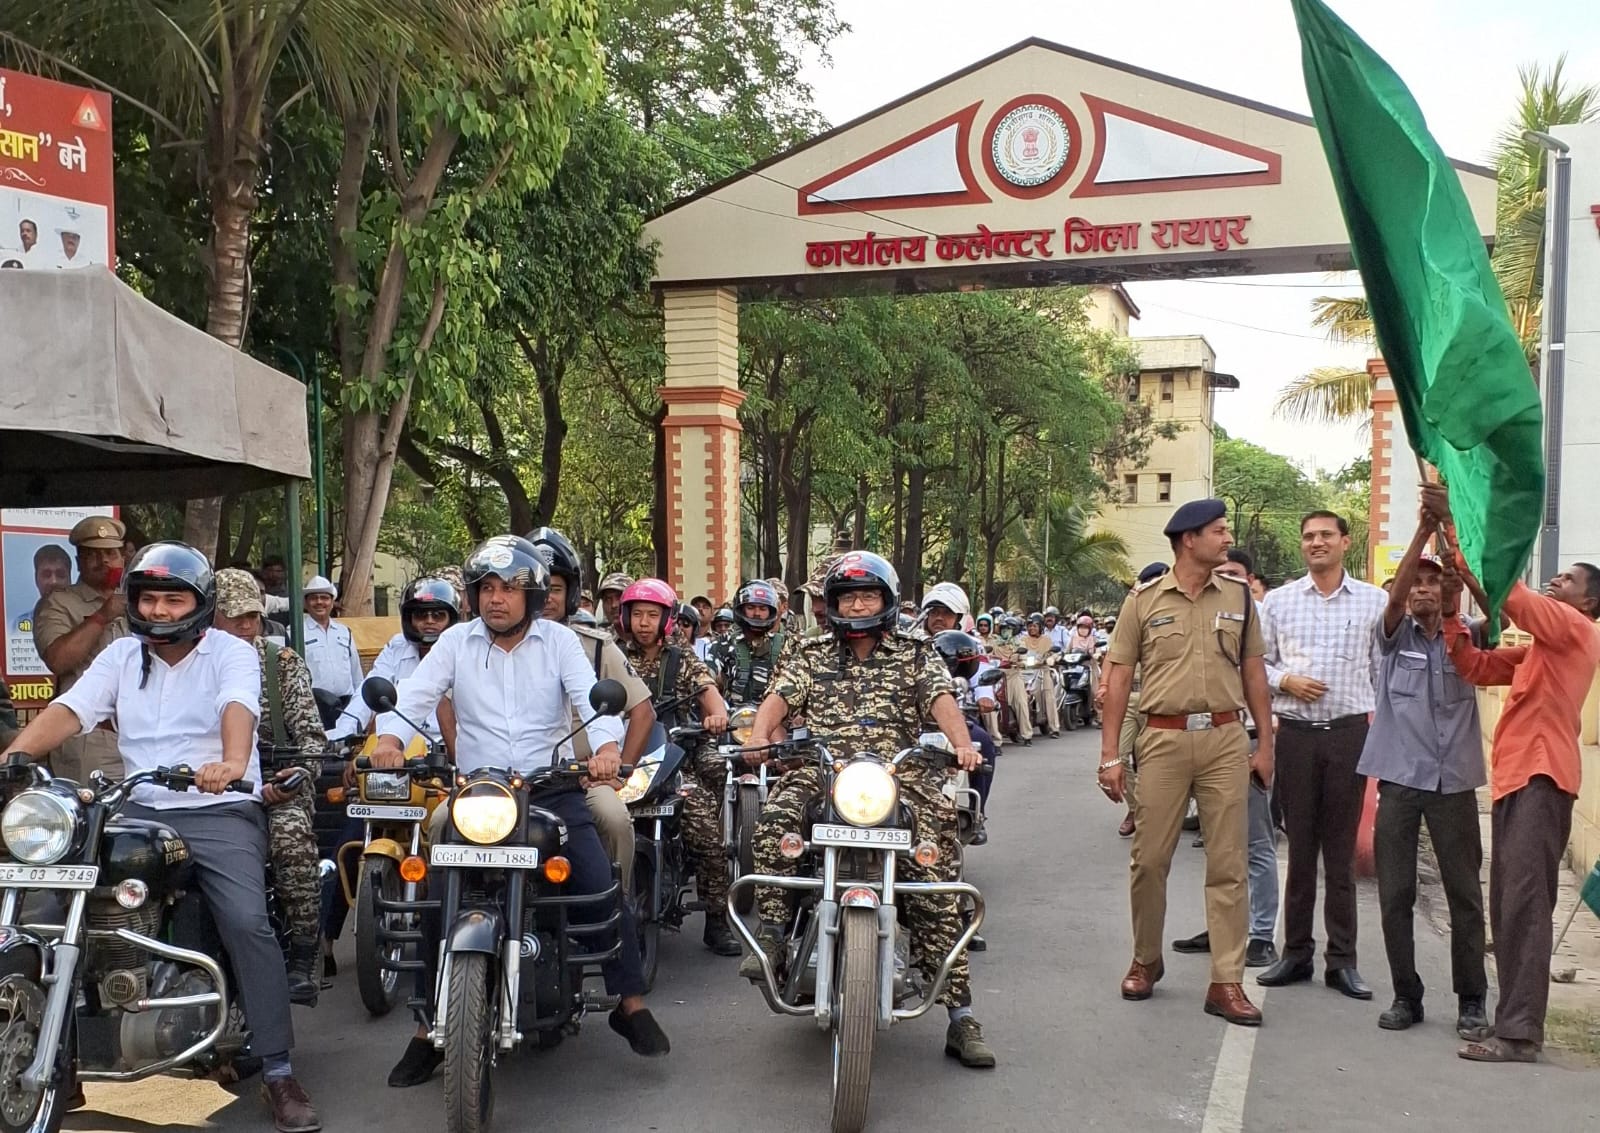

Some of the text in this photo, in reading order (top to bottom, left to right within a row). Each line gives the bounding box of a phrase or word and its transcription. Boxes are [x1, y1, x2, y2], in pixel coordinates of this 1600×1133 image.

[57, 135, 87, 173] बने
[805, 215, 1252, 267] कार्यालय कलेक्टर जिला रायपुर
[8, 677, 54, 700] आपके
[879, 832, 908, 841] 7953
[475, 853, 497, 863] ML
[505, 853, 533, 864] 1884
[30, 869, 46, 880] 03
[58, 869, 95, 881] 7949
